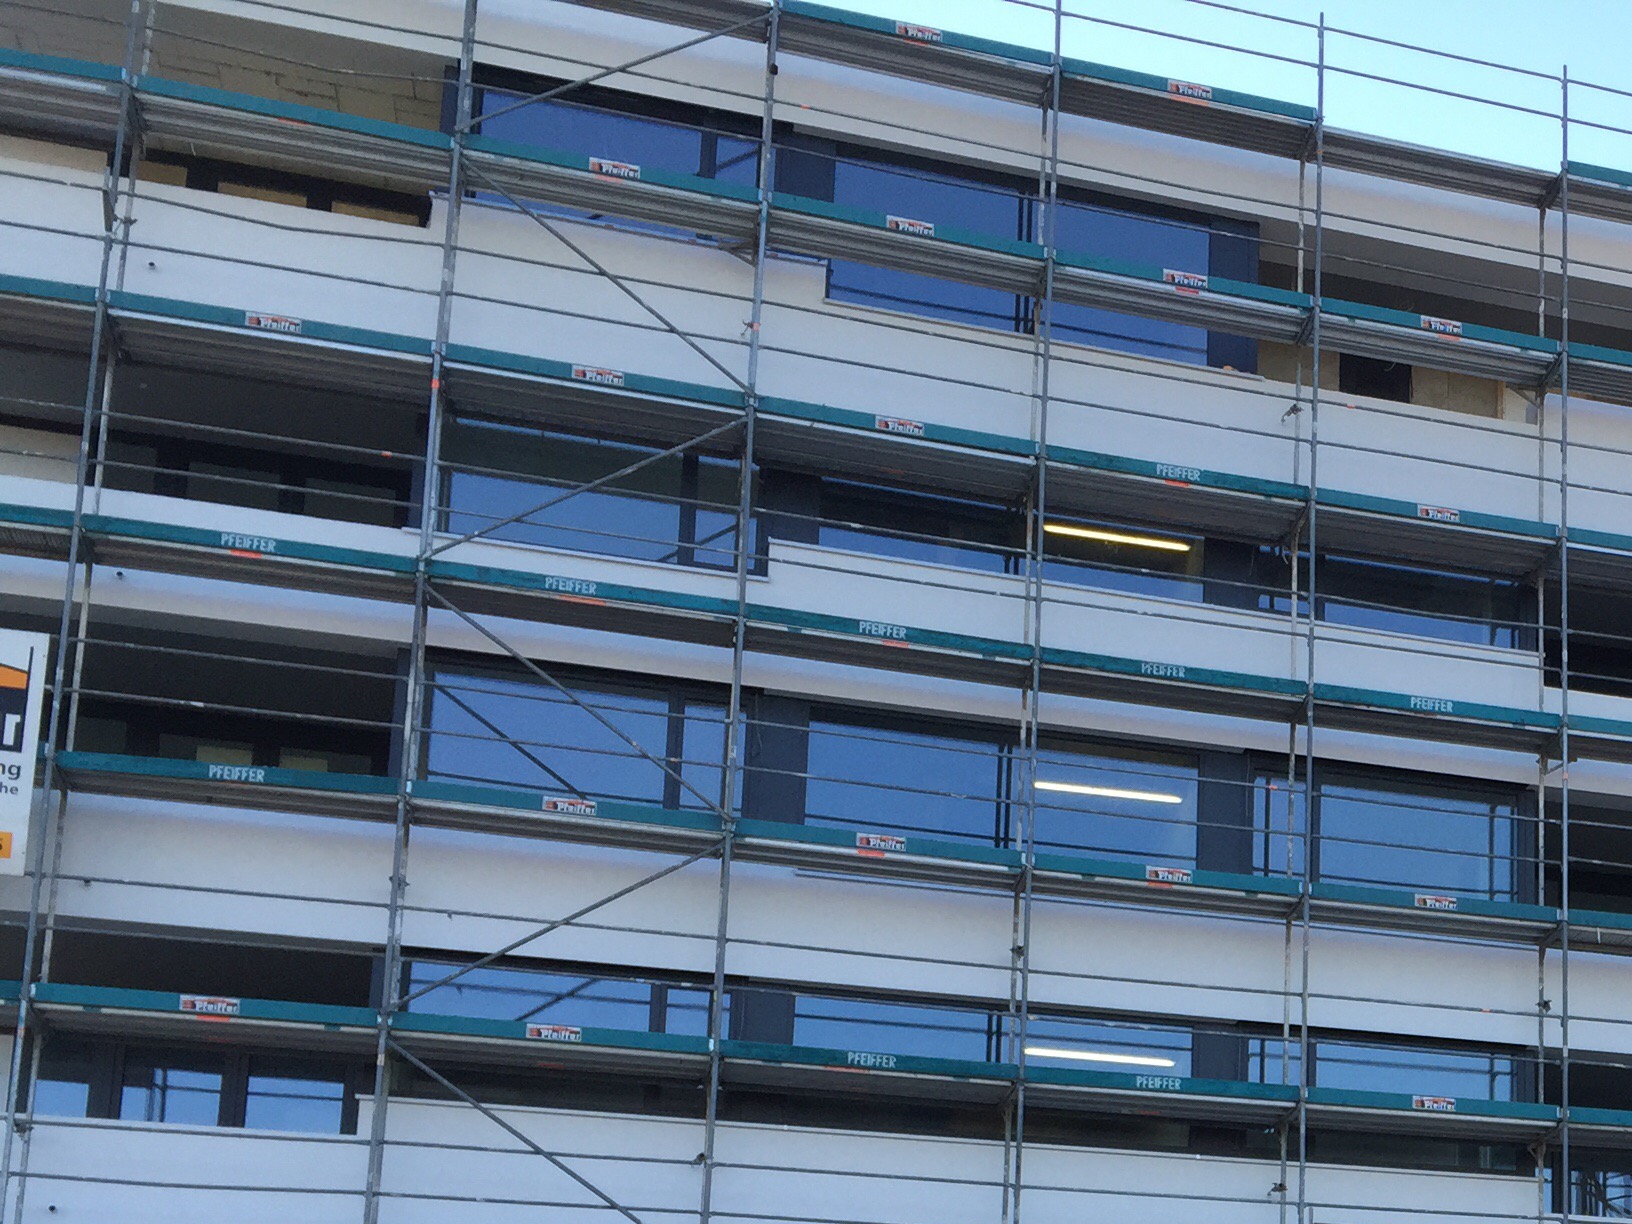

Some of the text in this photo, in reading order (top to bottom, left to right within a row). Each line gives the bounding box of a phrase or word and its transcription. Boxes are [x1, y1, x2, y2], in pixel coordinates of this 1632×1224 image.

[601, 163, 639, 178] Pfeiffer
[260, 317, 300, 332] Pfeiffer
[586, 371, 623, 386] Pfeiffer
[1156, 464, 1200, 481] PFEIFFER
[221, 533, 276, 552] PFEIFFER
[545, 577, 597, 595] PFEIFFER
[859, 621, 907, 639] PFEIFFER
[1141, 663, 1185, 677] PFEIFFER
[1410, 697, 1453, 712] PFEIFFER
[209, 765, 265, 782] PFEIFFER
[557, 801, 596, 815] Pfeiffer
[869, 838, 906, 851] Pfeiffer
[195, 1000, 239, 1013] Pfeiffer
[541, 1029, 581, 1041] Pfeiffer
[847, 1052, 896, 1068] PFEIFFER
[1136, 1076, 1180, 1090] PFEIFFER
